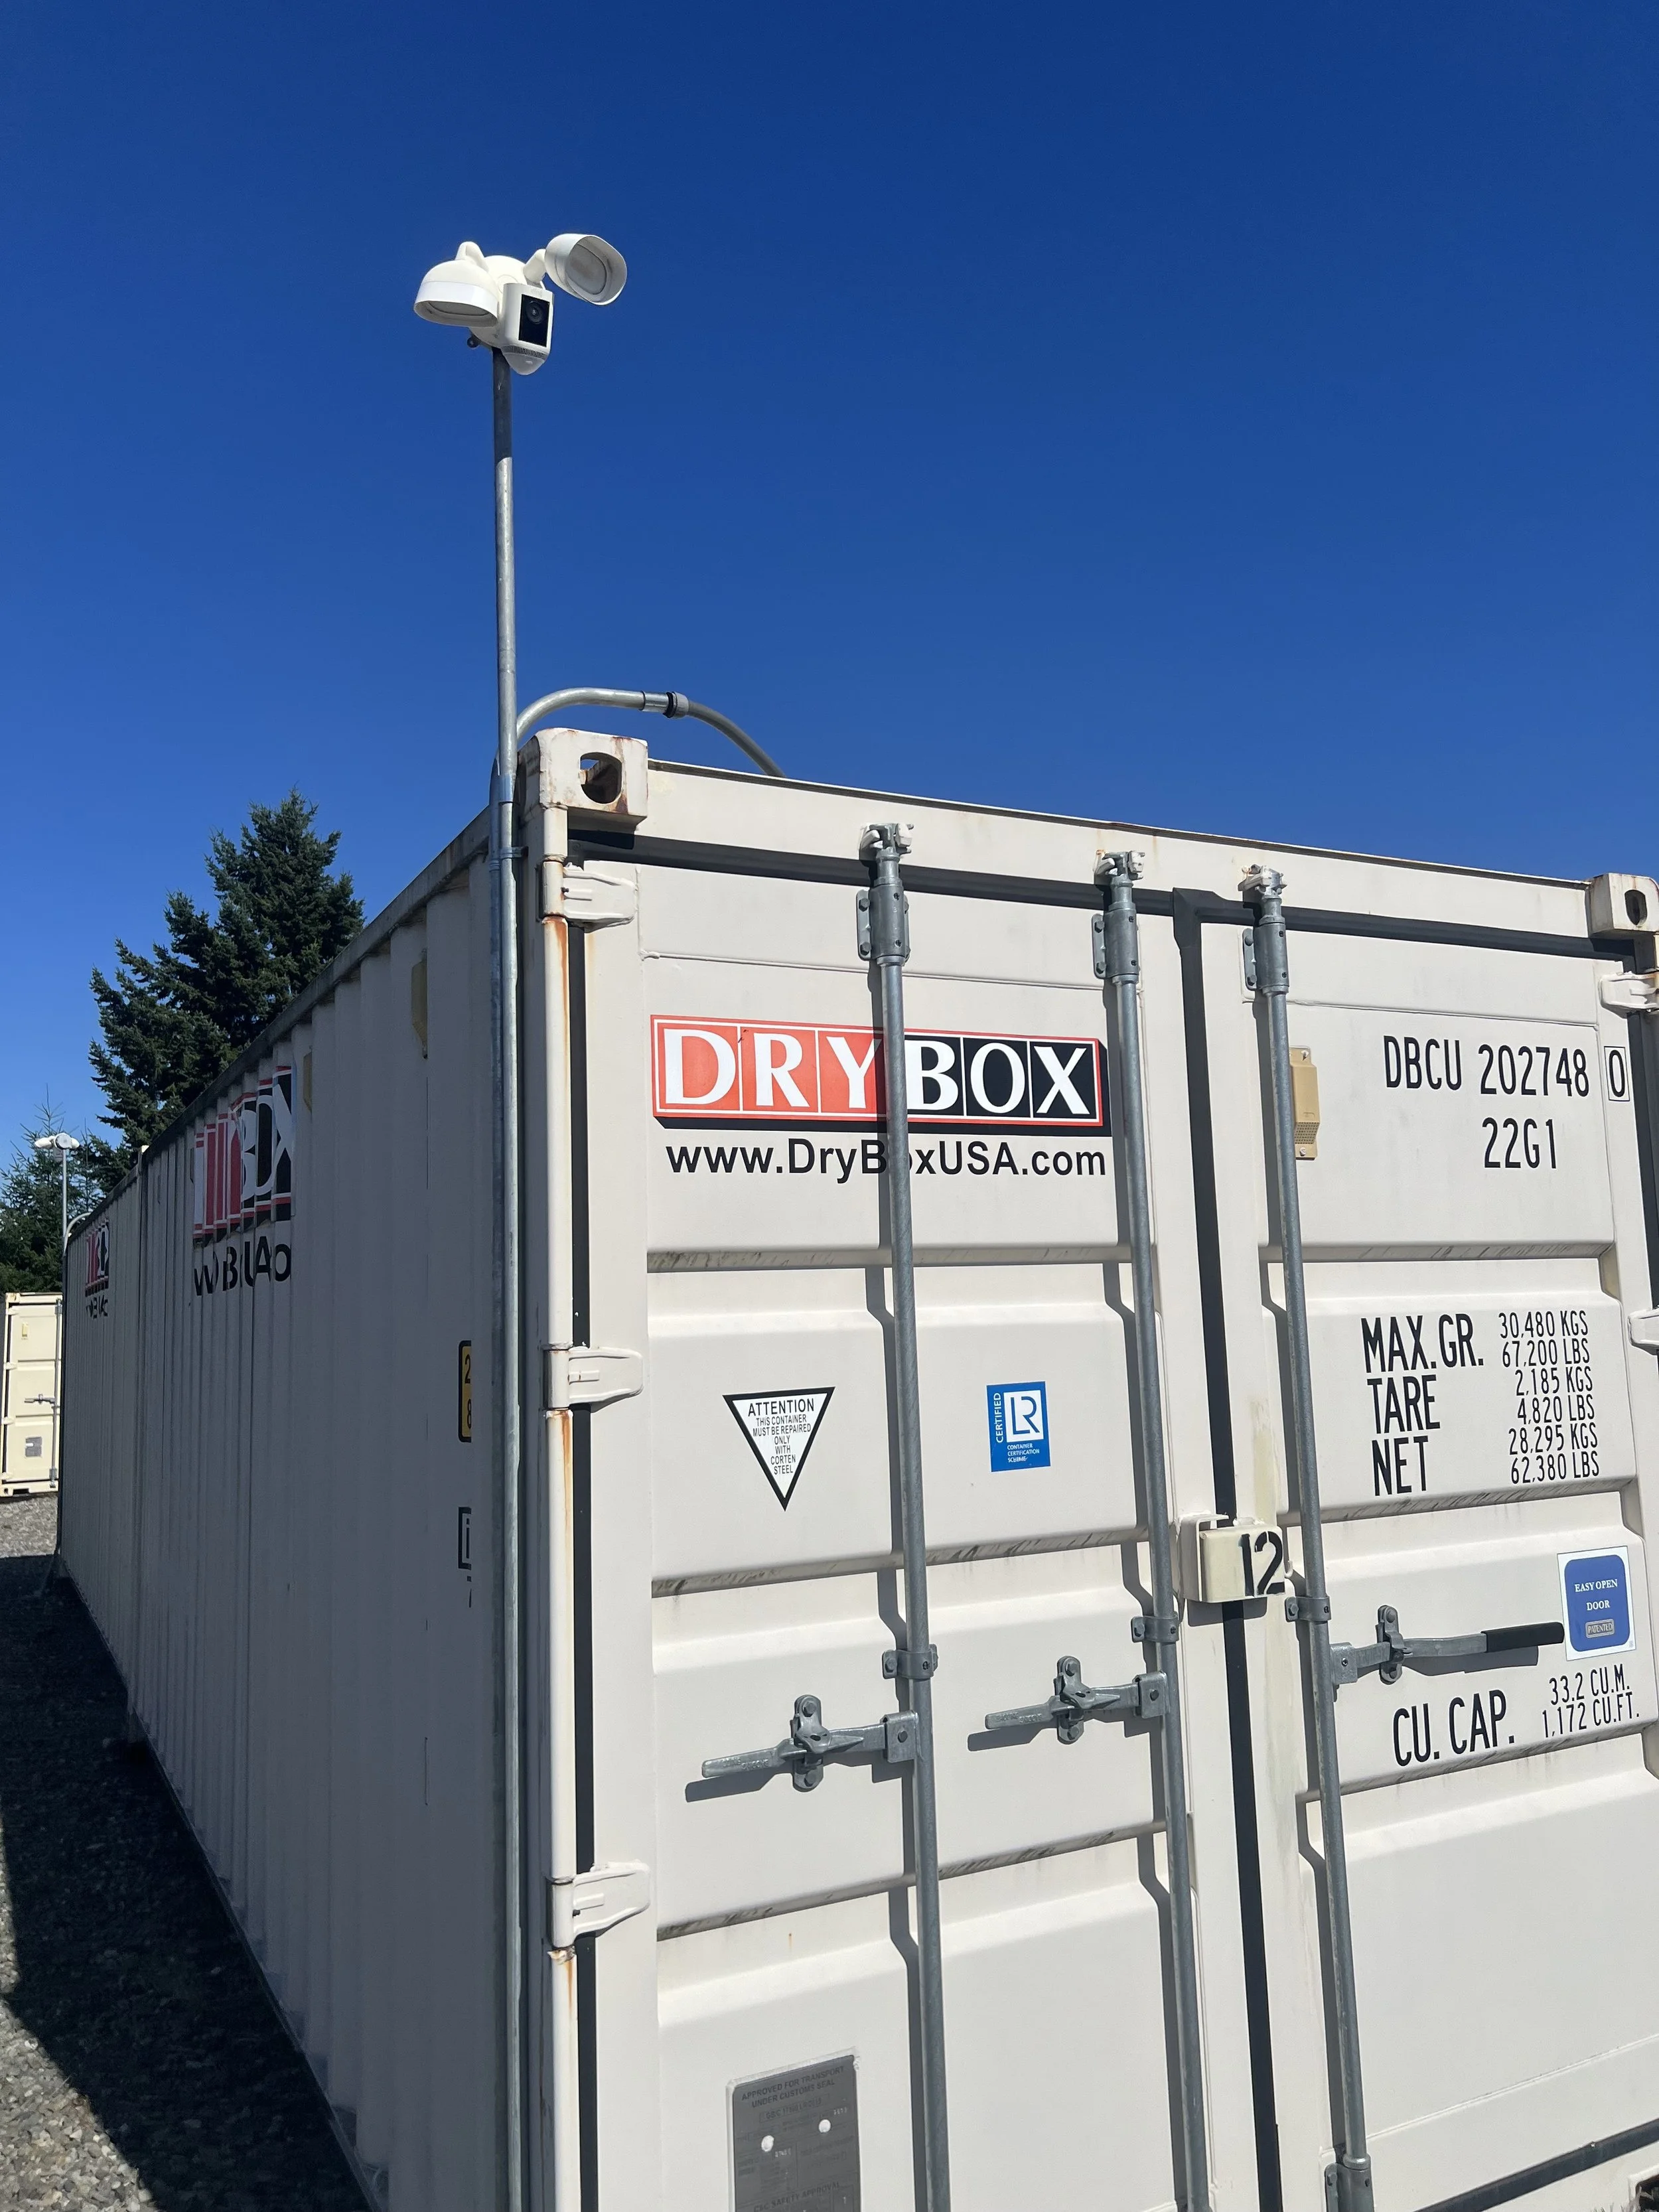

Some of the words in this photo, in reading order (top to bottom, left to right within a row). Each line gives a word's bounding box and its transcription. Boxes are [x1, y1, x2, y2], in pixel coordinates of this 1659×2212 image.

[664, 1028, 1090, 1115] DRYBOX
[1384, 1035, 1462, 1090] DBCU
[1478, 1044, 1589, 1097] 202748
[1609, 1049, 1626, 1097] 0
[1482, 1117, 1556, 1169] 22G1
[666, 1138, 1105, 1183] www.DryBxUSA.com
[1498, 1311, 1555, 1339] 30,480
[1560, 1310, 1588, 1336] KGS
[1502, 1339, 1558, 1367] 67,200
[1563, 1338, 1590, 1364] LBS
[748, 1398, 814, 1417] ATTENTION
[1367, 1374, 1441, 1434] TARE
[1514, 1368, 1559, 1396] 2,185
[1565, 1366, 1593, 1392] KGS
[1517, 1396, 1562, 1424] 4,820
[1568, 1394, 1595, 1421] LBS
[753, 1427, 770, 1437] MUST
[771, 1426, 780, 1435] BE
[781, 1424, 811, 1434] REPAIRED
[757, 1416, 770, 1426] THIS
[772, 1414, 807, 1425] CONTAINER
[993, 1392, 1004, 1443] CERTIFIED
[1011, 1396, 1040, 1435] LR
[774, 1436, 790, 1445] ONLY
[775, 1445, 791, 1455] WITH
[770, 1454, 796, 1465] CORTEN
[774, 1465, 794, 1475] STEEL
[1372, 1435, 1429, 1497] NET
[1508, 1424, 1564, 1455] 28,295
[1571, 1422, 1598, 1449] KGS
[1511, 1453, 1567, 1484] 62,380
[1572, 1451, 1599, 1478] LBS
[1238, 1531, 1285, 1596] 12
[1574, 1582, 1595, 1592] EASY
[1595, 1578, 1618, 1589] OPEN
[1586, 1600, 1610, 1611] DOOR
[1588, 1623, 1613, 1634] PATENTED
[1393, 1703, 1440, 1767] CU.
[1449, 1689, 1515, 1755] CAP.
[1549, 1672, 1585, 1706] 33.2
[1542, 1702, 1587, 1738] 1,172
[741, 2083, 782, 2101] APPROVED
[784, 2078, 800, 2090] FOR
[801, 2065, 845, 2084] TRANSPORT
[752, 2095, 778, 2108] UNDER
[780, 2084, 816, 2100] CUSTOMS
[817, 2079, 835, 2089] SEAL
